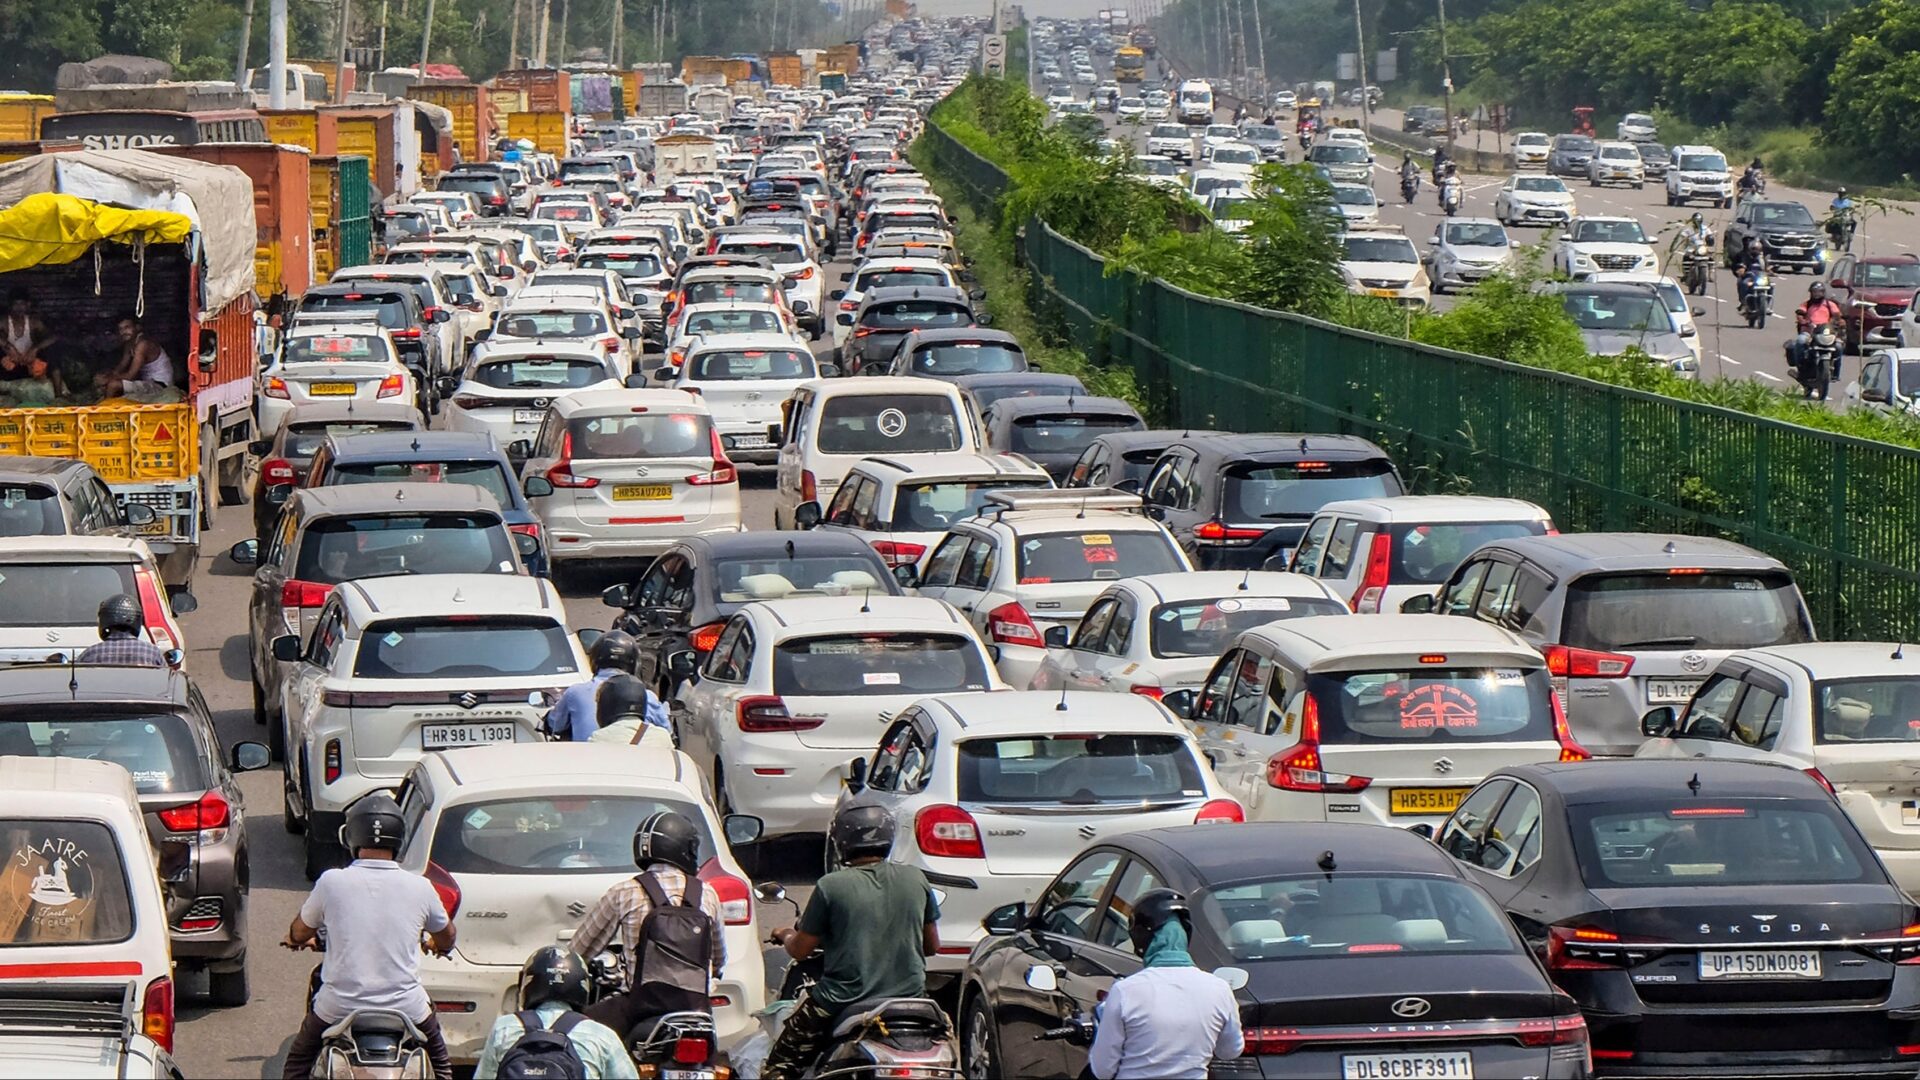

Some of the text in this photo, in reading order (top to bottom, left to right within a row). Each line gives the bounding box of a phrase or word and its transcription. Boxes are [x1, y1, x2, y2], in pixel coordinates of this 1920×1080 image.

[66, 134, 175, 151] SHOK
[432, 727, 512, 743] HR 98 L 1303
[1401, 790, 1468, 808] HR55AH7
[16, 837, 89, 868] JAATRE
[1712, 954, 1819, 973] UP15DN0081
[1368, 1024, 1453, 1033] VERNA
[523, 1067, 548, 1076] safari
[1356, 1057, 1470, 1079] DL8CBF3911
